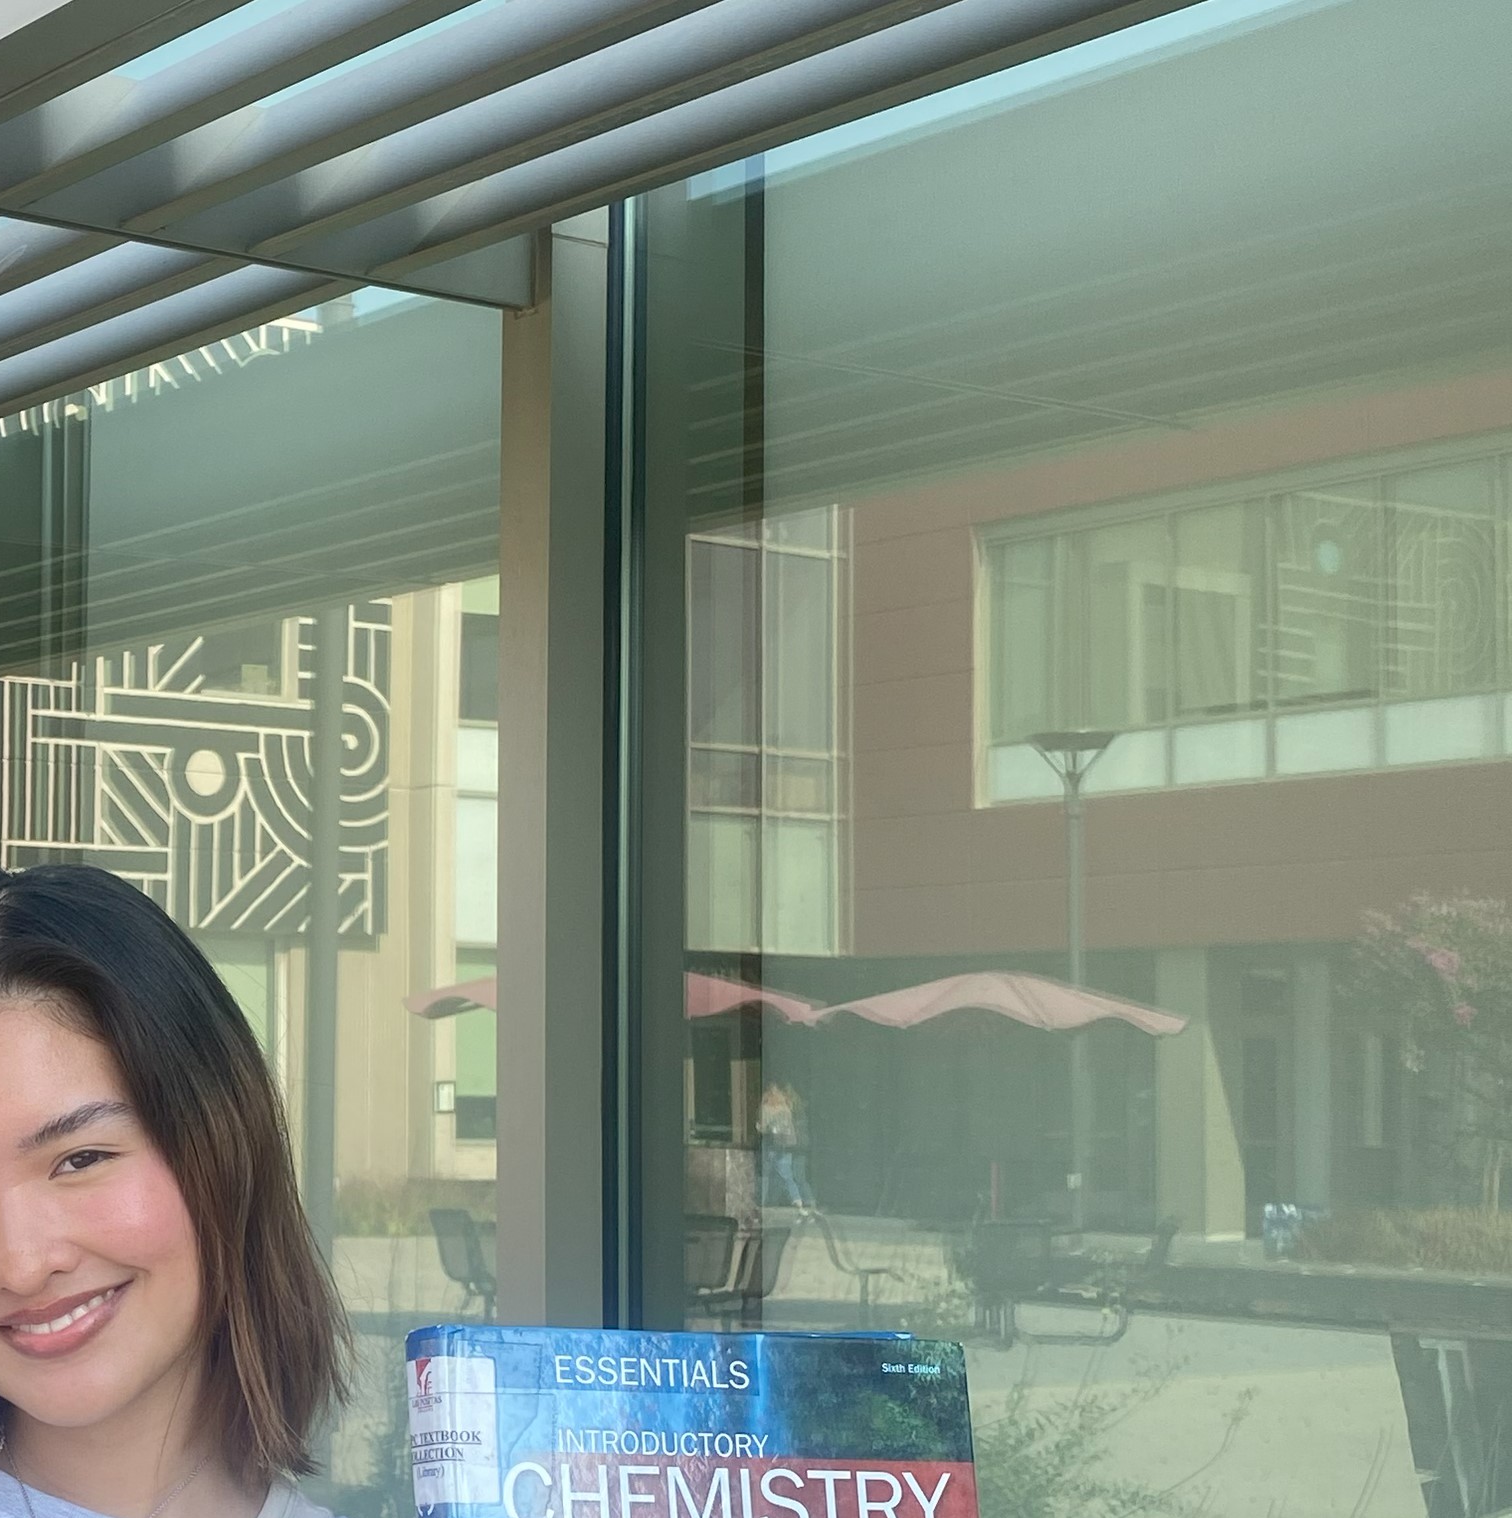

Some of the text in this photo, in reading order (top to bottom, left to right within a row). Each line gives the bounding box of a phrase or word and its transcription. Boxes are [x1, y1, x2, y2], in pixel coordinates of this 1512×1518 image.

[554, 1355, 750, 1390] ESSENTIALS
[881, 1362, 941, 1375] Sixth Edition
[419, 1430, 481, 1444] TEXTBOOK
[557, 1427, 769, 1459] INTRODUCTORY
